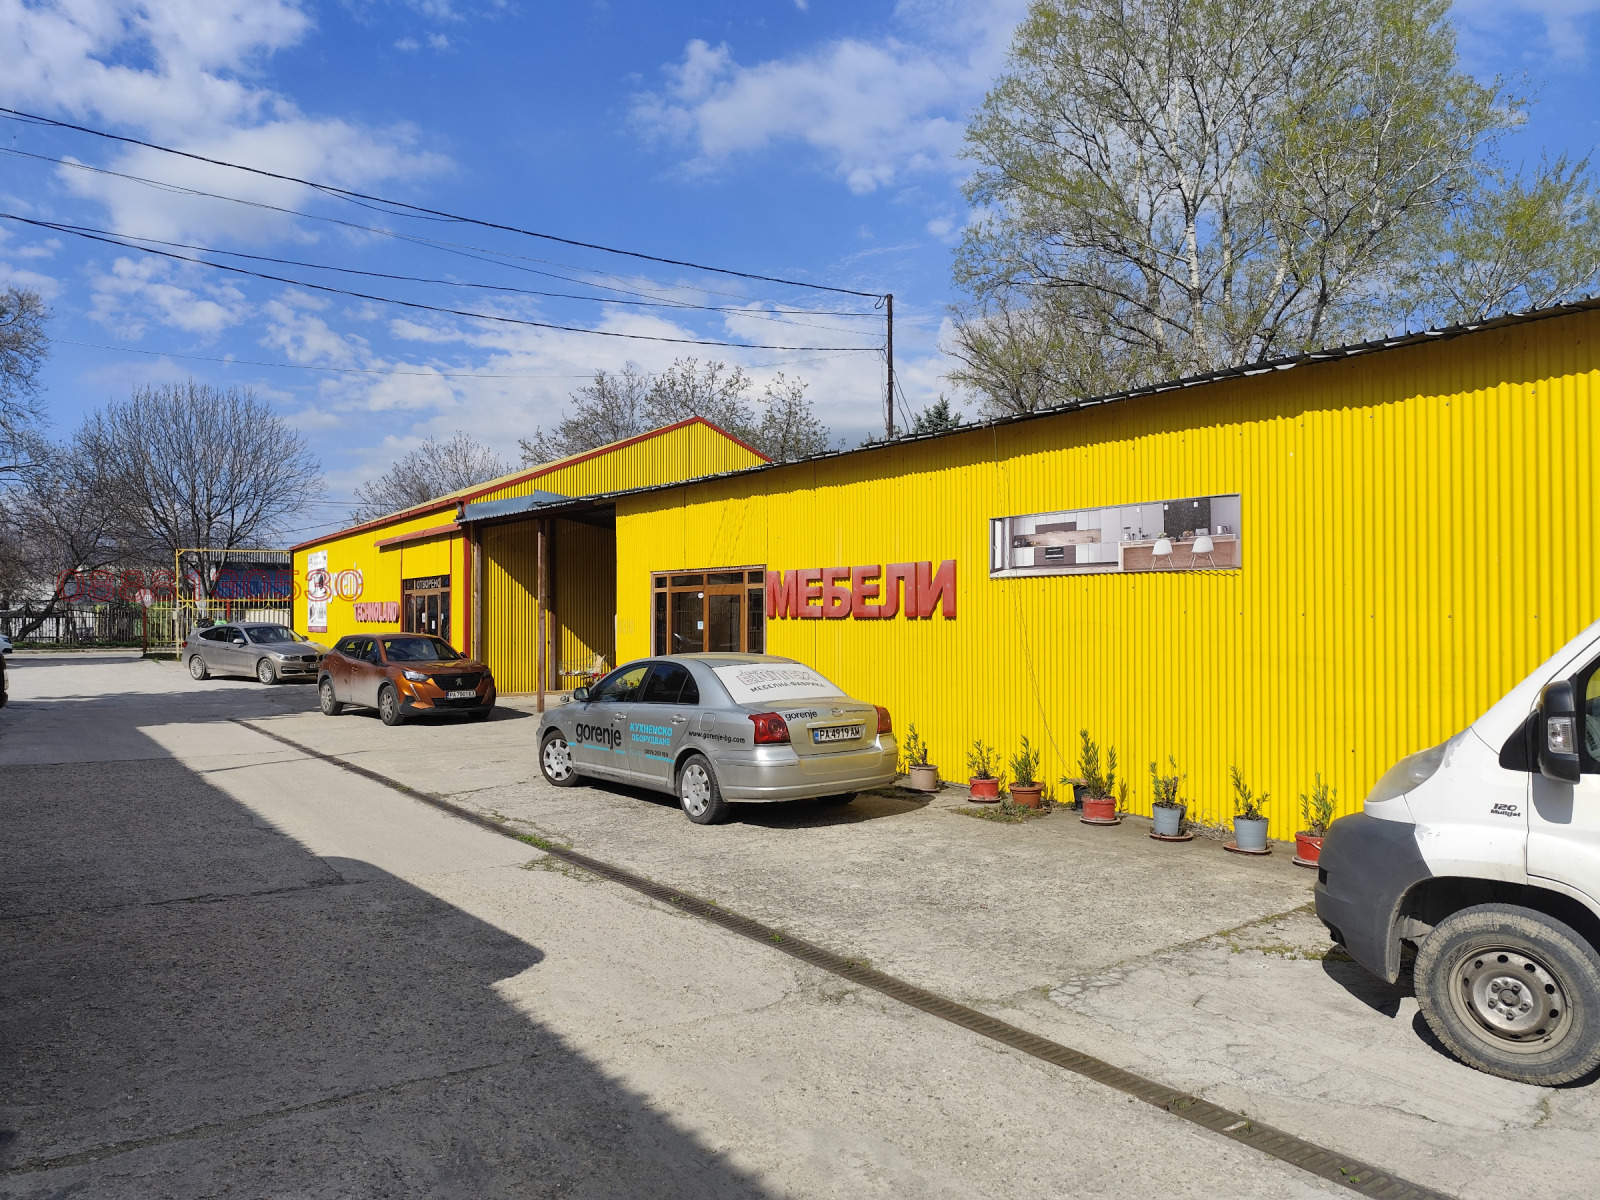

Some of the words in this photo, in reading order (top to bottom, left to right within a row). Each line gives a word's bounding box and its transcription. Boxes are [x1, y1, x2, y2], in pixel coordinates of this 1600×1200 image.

[767, 559, 957, 618] МЕБЕЛИ
[353, 601, 400, 623] TECHNOLAND
[785, 710, 818, 721] gorenje
[576, 722, 622, 749] gorenje
[630, 722, 673, 737] КУХНЕНСКО
[831, 728, 849, 739] 4919
[632, 734, 671, 746] ОБОРУДВАНЕ
[688, 730, 746, 744] www.gorenje-bg.com
[1494, 803, 1518, 811] 120
